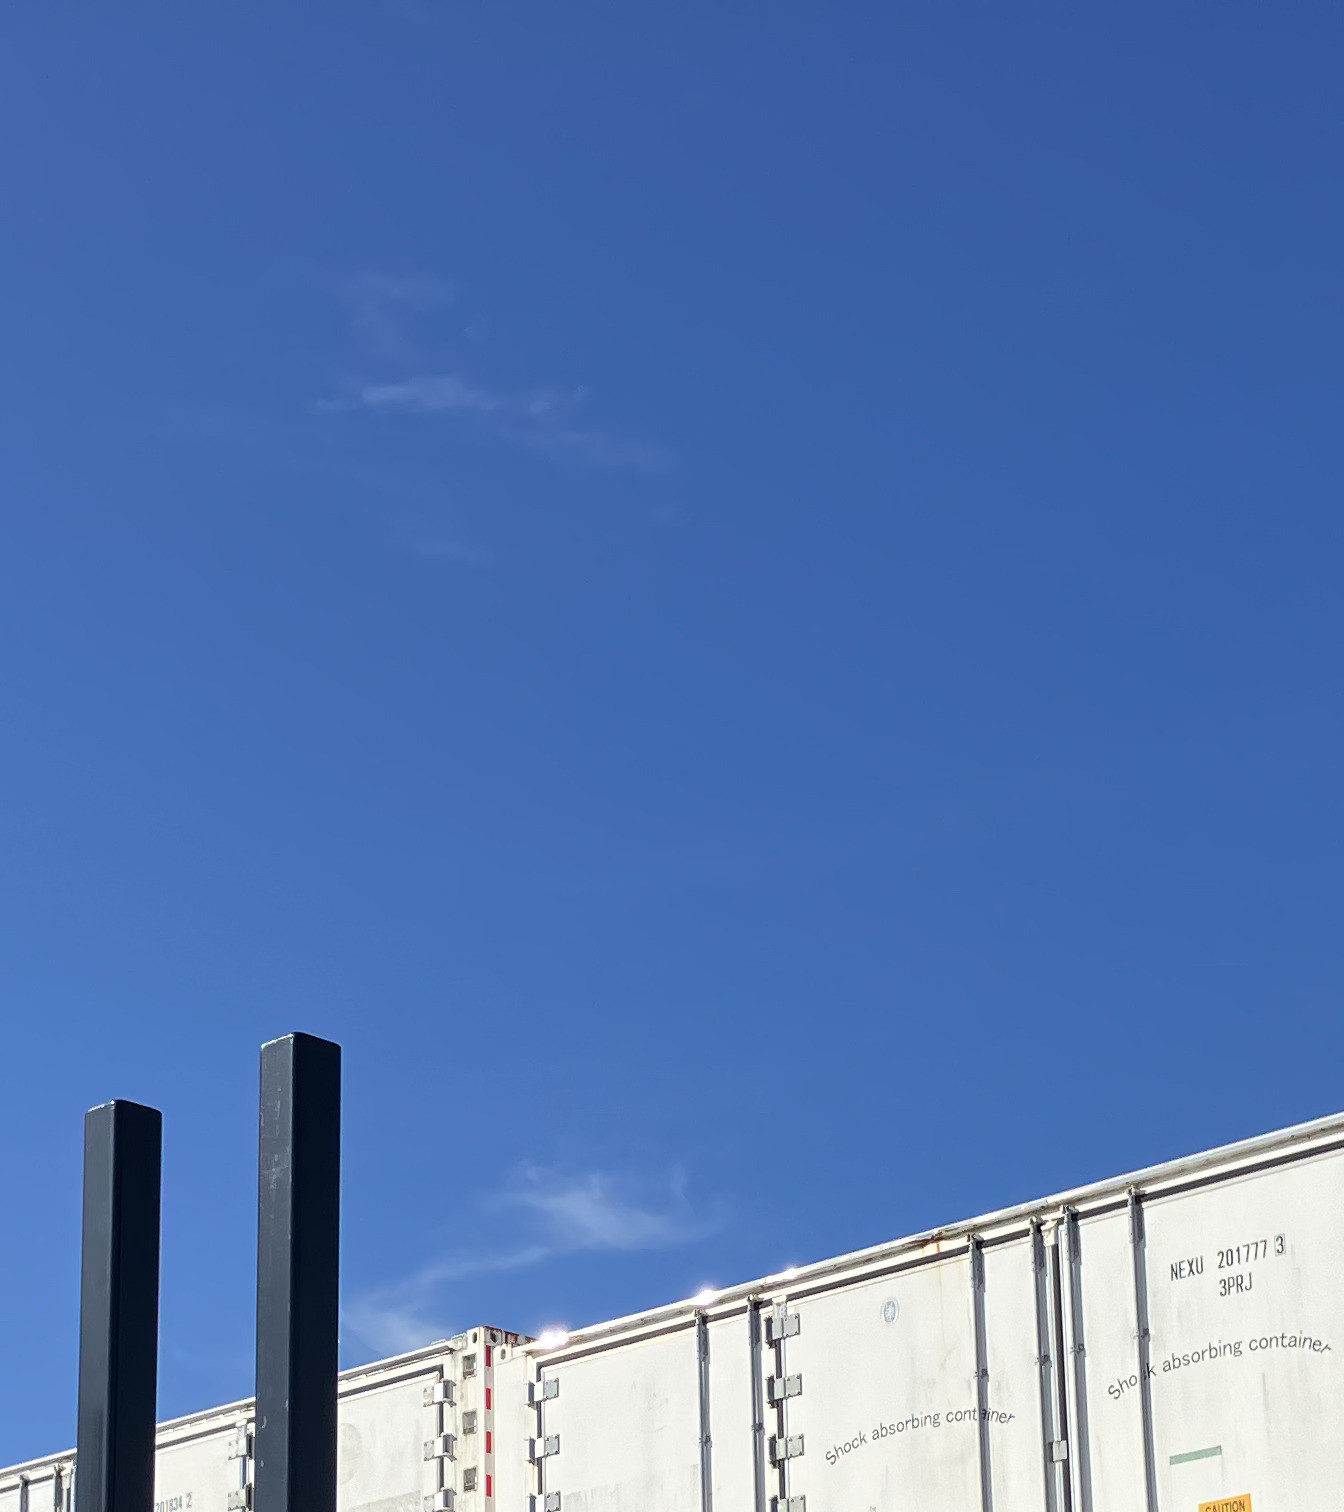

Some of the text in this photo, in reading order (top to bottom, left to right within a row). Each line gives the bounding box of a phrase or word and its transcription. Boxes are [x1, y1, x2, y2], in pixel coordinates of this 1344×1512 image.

[1170, 1234, 1285, 1281] NEXU 201777 3
[1219, 1272, 1253, 1297] 3PRJ
[1162, 1340, 1243, 1373] absorbing
[1249, 1330, 1332, 1355] container
[872, 1411, 941, 1441] absorbing
